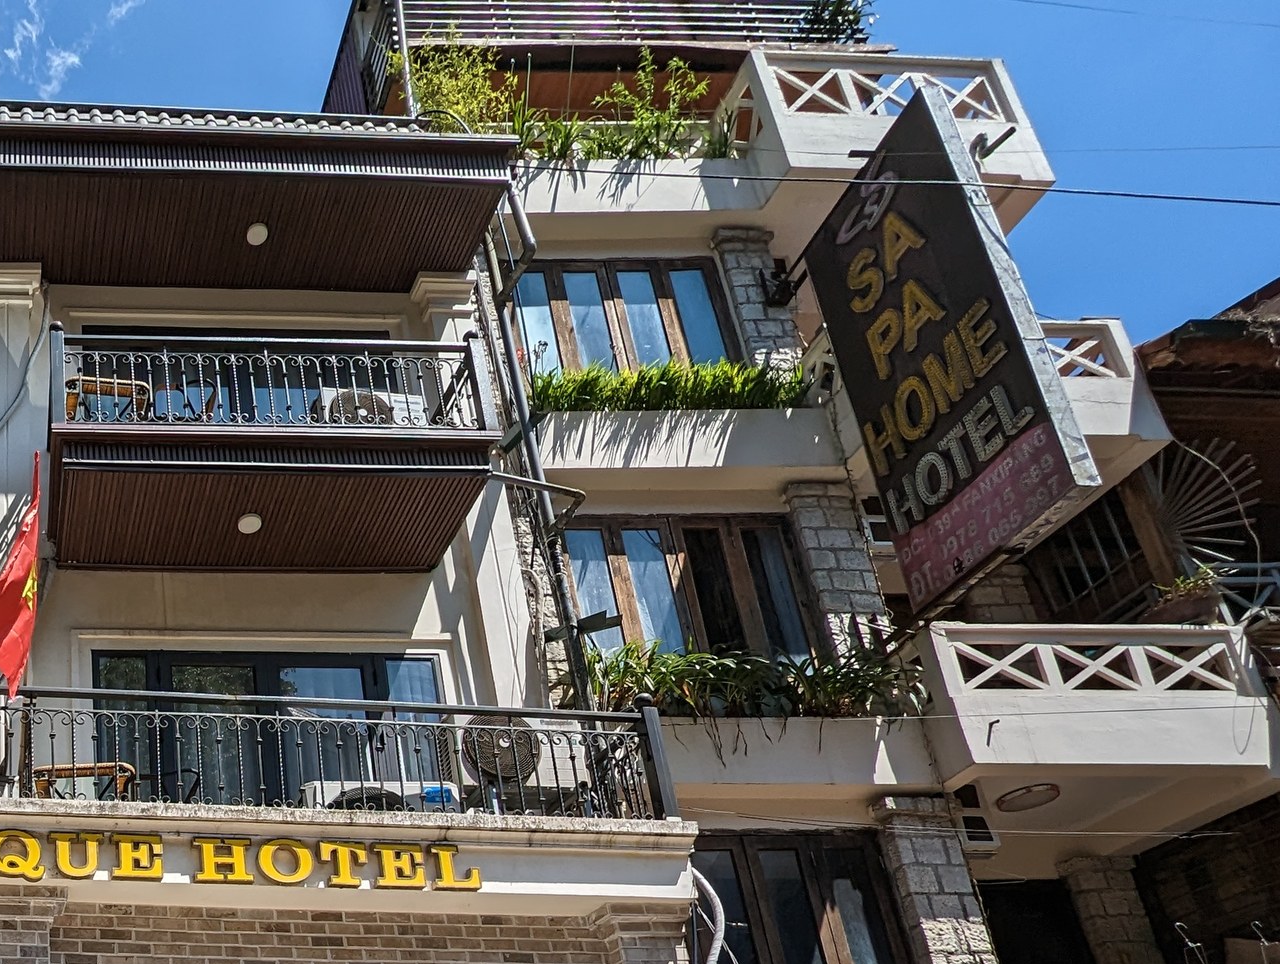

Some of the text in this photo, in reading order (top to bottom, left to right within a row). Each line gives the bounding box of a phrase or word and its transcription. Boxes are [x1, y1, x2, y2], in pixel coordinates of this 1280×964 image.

[863, 298, 1008, 477] HOME
[886, 385, 1036, 536] HOTEL
[192, 836, 483, 892] HOTEL
